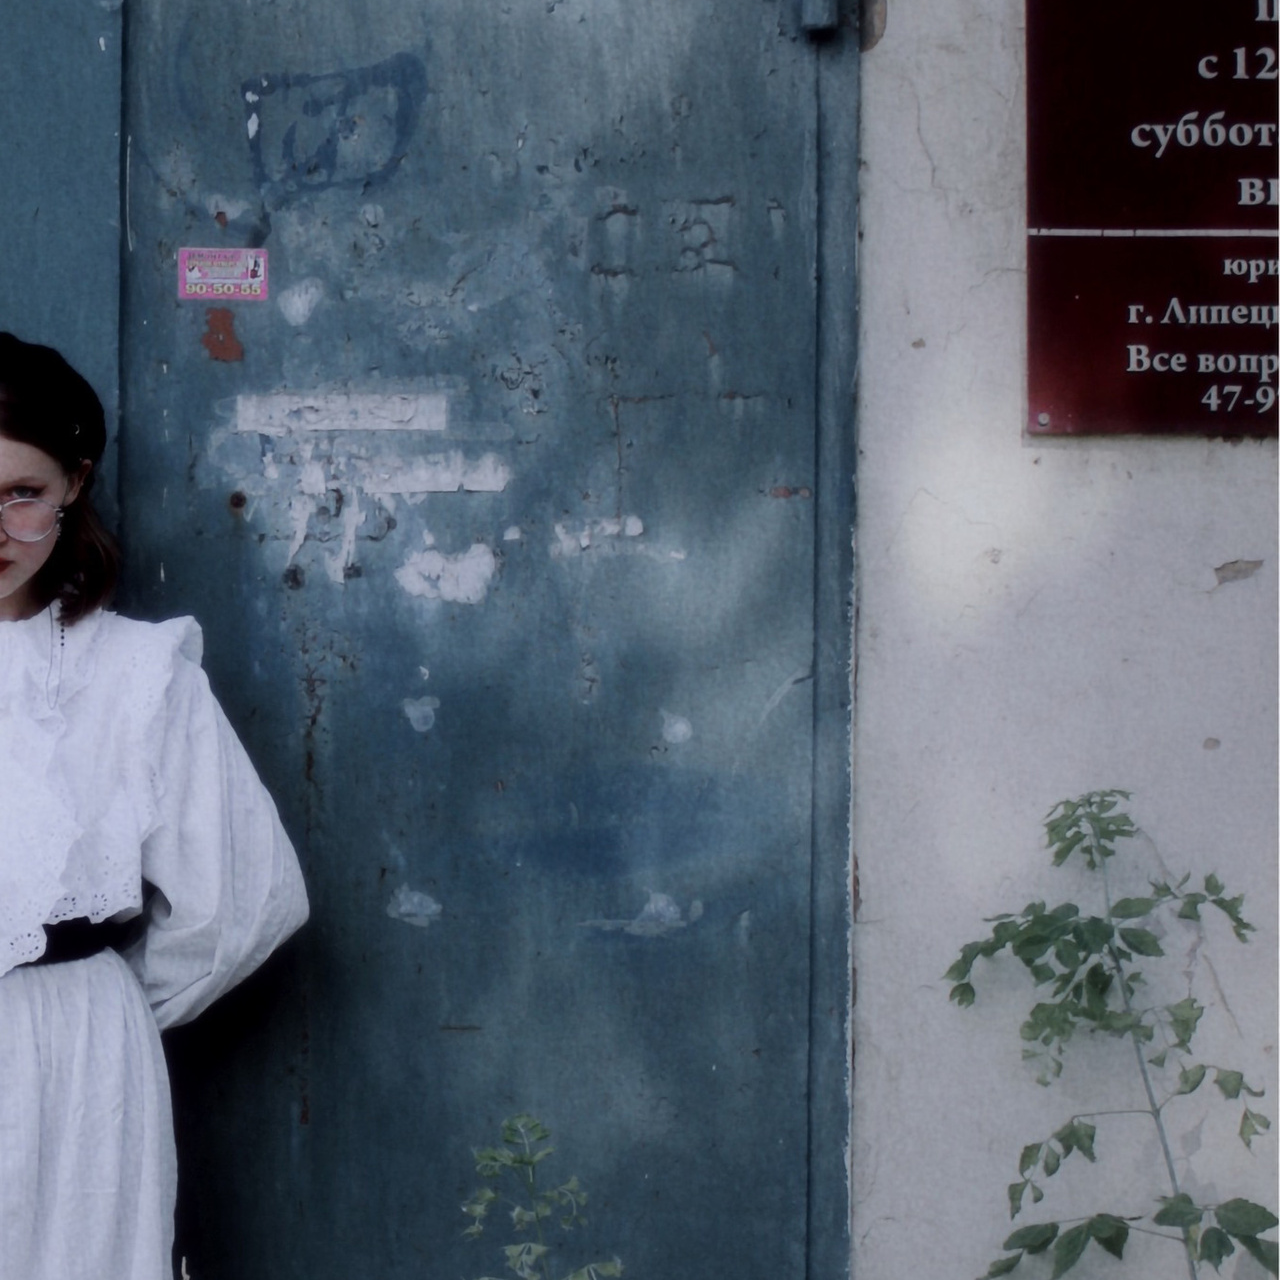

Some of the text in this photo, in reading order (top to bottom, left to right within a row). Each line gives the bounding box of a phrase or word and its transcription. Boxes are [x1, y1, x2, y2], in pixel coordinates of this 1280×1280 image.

[1198, 55, 1218, 79] с
[1130, 111, 1278, 158] суббот
[186, 283, 261, 295] 90-50-55
[1127, 297, 1278, 329] г. Липец
[1126, 345, 1187, 373] Все
[1201, 384, 1278, 414] 47-9
